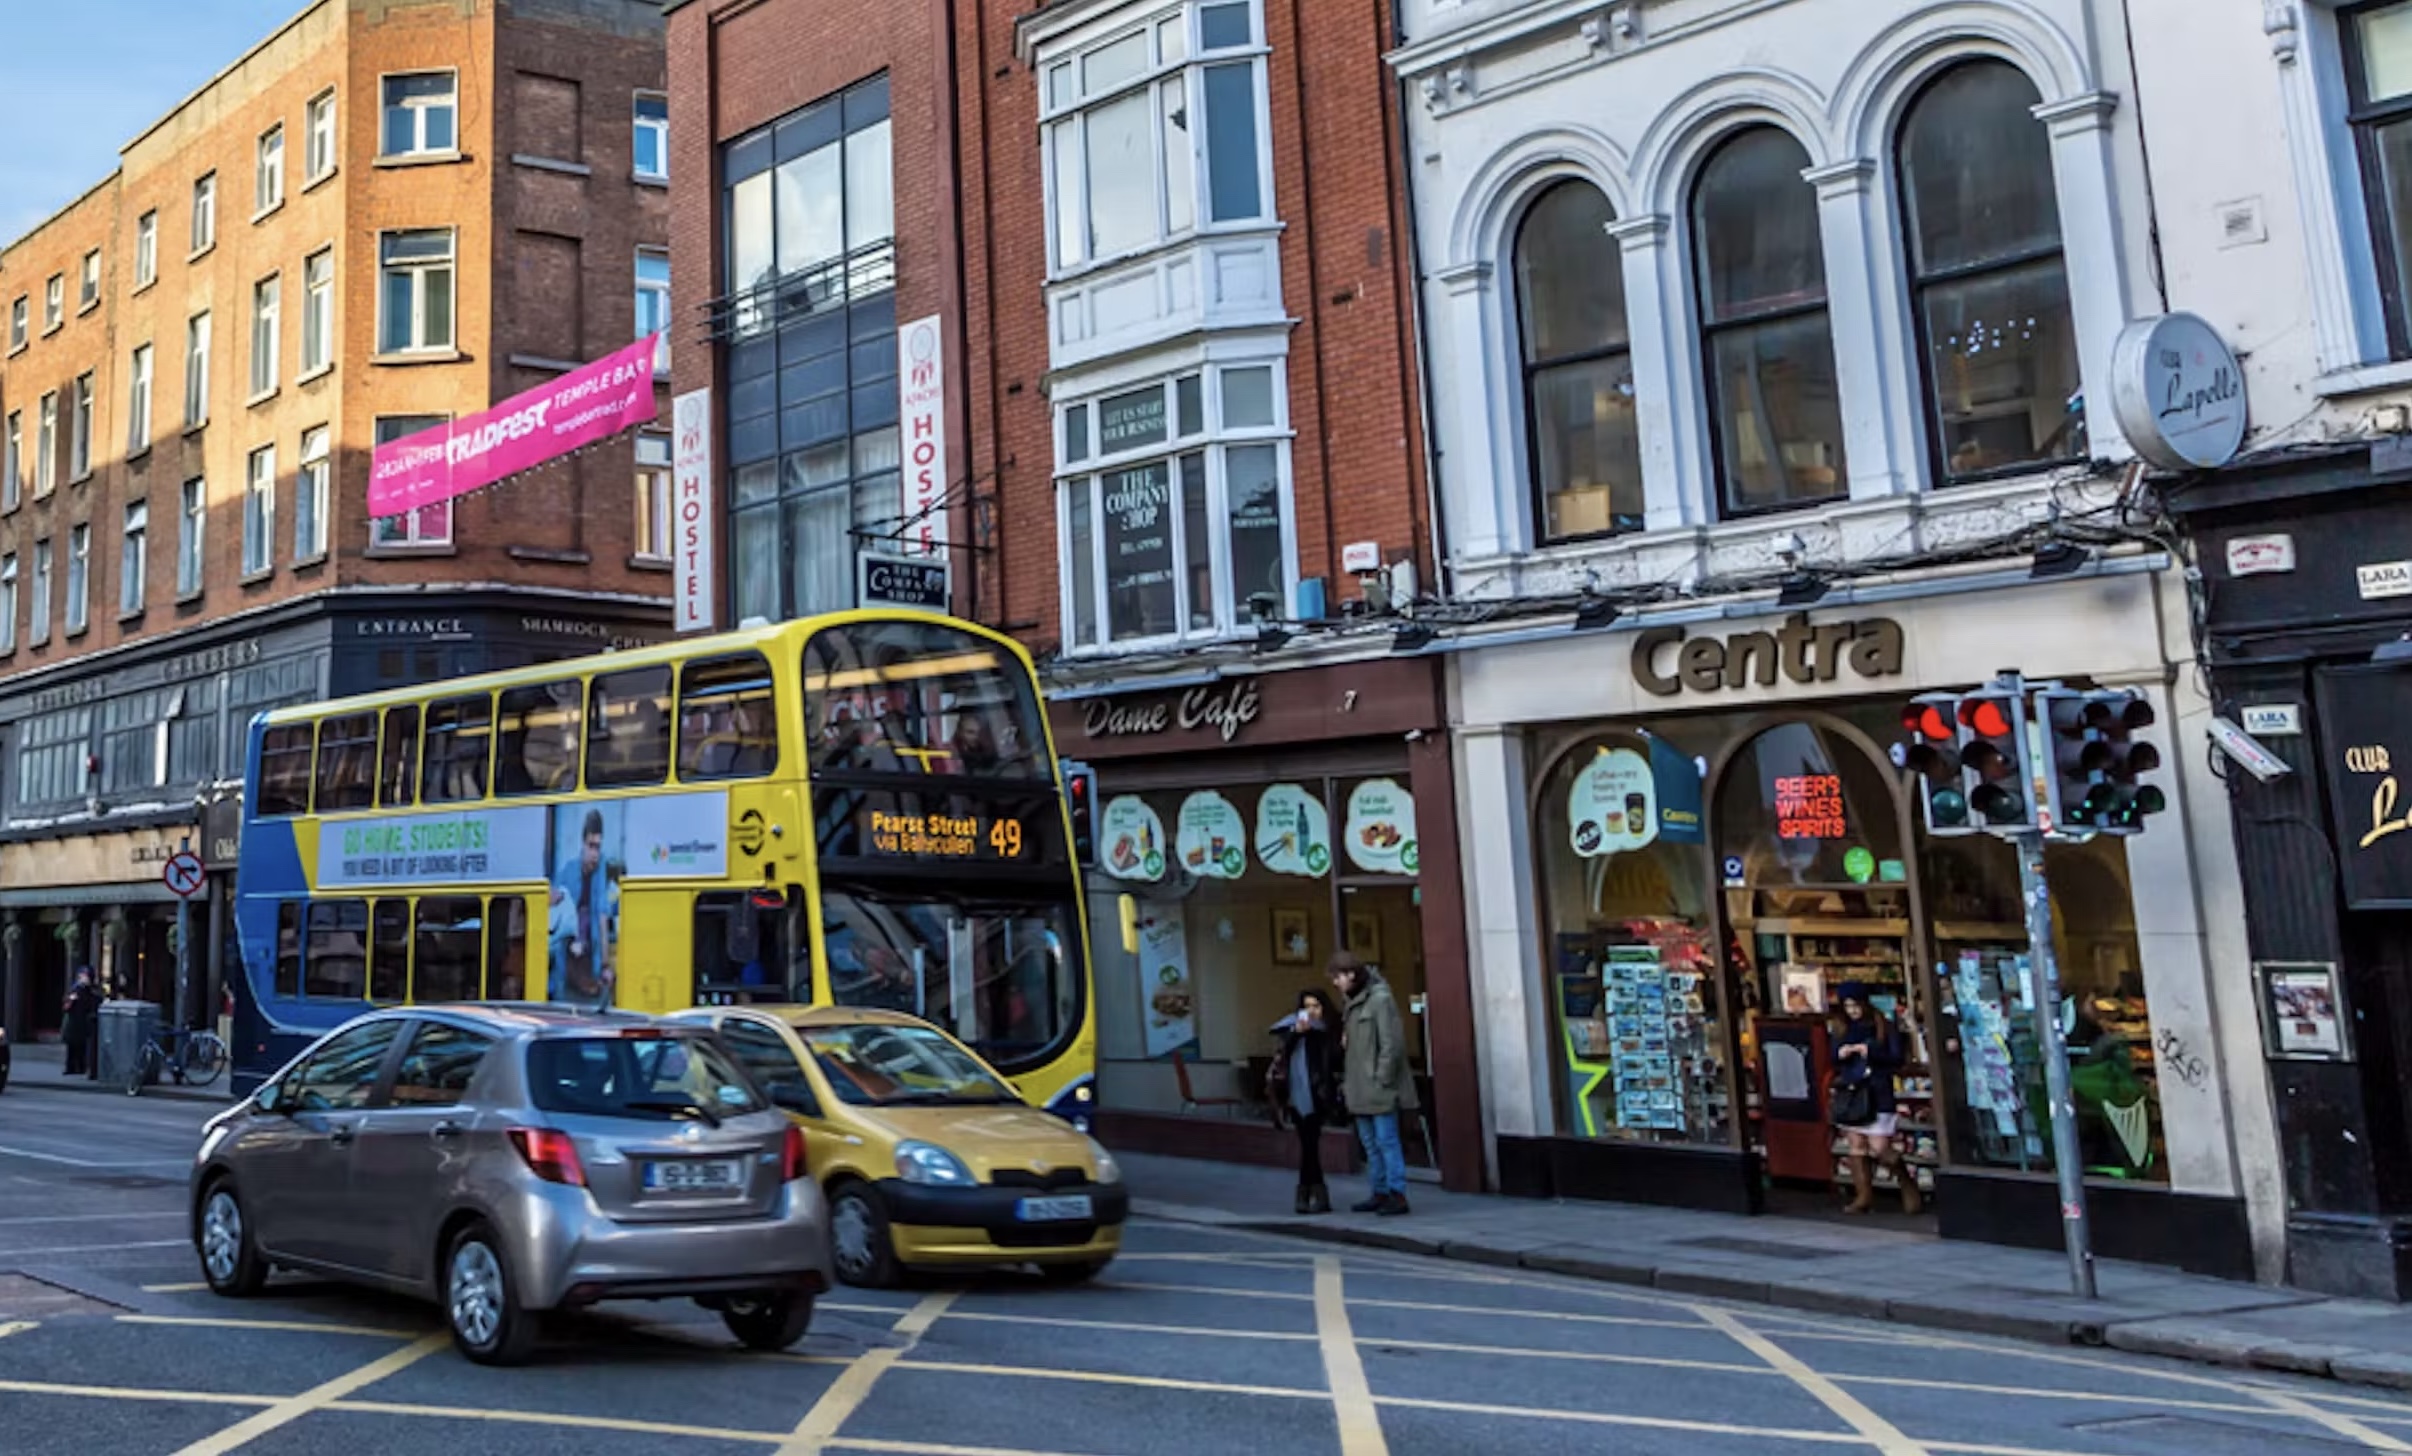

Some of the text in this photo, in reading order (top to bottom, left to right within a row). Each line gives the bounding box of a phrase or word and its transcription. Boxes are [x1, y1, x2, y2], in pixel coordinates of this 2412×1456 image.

[554, 371, 611, 410] TEMPLE
[681, 477, 701, 620] HOSTEL
[2362, 568, 2408, 585] LARA
[356, 619, 464, 635] ENTRANCE
[521, 617, 609, 637] SHAMROCK
[1631, 610, 1904, 696] Centra
[1081, 682, 1259, 742] Dame Café
[1344, 689, 1357, 712] 7
[1775, 774, 1841, 799] BEERS
[1775, 796, 1843, 818] WINES
[871, 810, 977, 836] Pearse Street
[1778, 817, 1846, 839] SPIRITS
[989, 818, 1021, 857] 49
